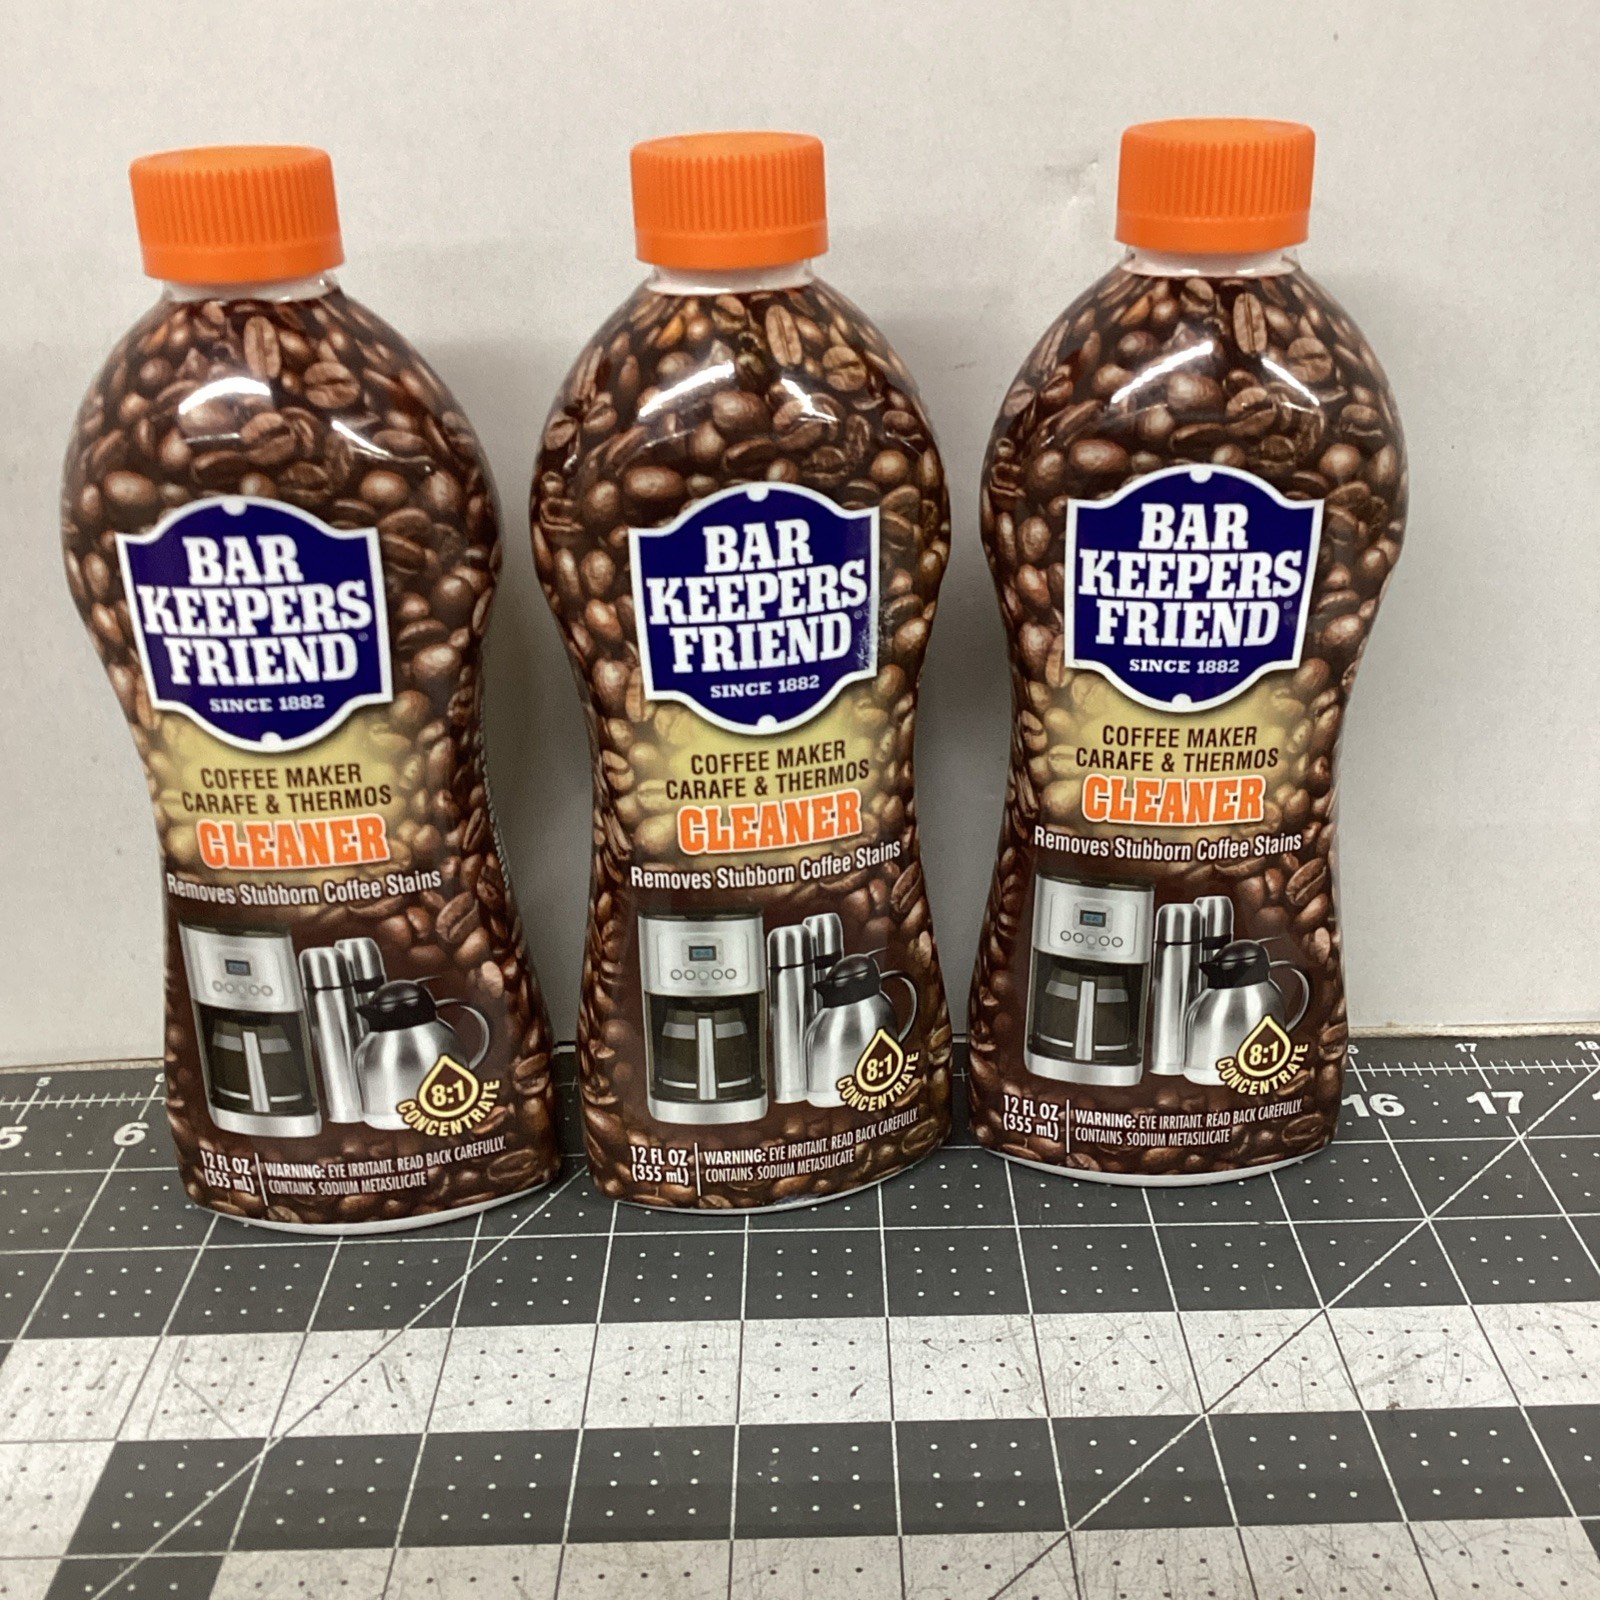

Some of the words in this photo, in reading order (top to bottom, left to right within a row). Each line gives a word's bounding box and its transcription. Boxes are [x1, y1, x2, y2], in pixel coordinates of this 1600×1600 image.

[1138, 503, 1249, 550] BAR
[182, 535, 304, 585] BAR
[703, 518, 813, 573] BAR
[1078, 549, 1302, 600] KEEPERS
[646, 559, 868, 625] KEEPERS
[137, 580, 372, 636] KEEPERS
[1095, 598, 1280, 647] FRIEND
[669, 612, 852, 673] FRIEND
[163, 633, 358, 686] FRIEND
[1129, 659, 1190, 674] SINCE
[1197, 659, 1239, 674] 1882
[710, 682, 772, 698] SINCE
[778, 675, 819, 692] 1882
[209, 697, 272, 713] SINCE
[279, 695, 325, 711] 1882
[1102, 724, 1180, 747] COFFEE
[1187, 726, 1257, 748] MAKER
[691, 754, 770, 775] COFFEE
[777, 740, 846, 769] MAKER
[1076, 747, 1153, 771] CARAFE
[1161, 753, 1175, 772] &
[1184, 747, 1279, 772] THERMOS
[200, 766, 279, 790] COFFEE
[286, 763, 361, 787] MAKER
[666, 776, 746, 800] CARAFE
[754, 776, 768, 795] &
[775, 759, 869, 793] THERMOS
[182, 791, 258, 815] CARAFE
[266, 795, 280, 813] &
[289, 786, 391, 811] THERMOS
[1082, 774, 1266, 826] CLEANER
[677, 788, 862, 855] CLEANER
[197, 814, 390, 869] CLEANER
[1034, 826, 1109, 857] Removes
[1114, 837, 1191, 861] Stubborn
[1196, 839, 1249, 861] Coffee
[1254, 833, 1302, 857] Stains
[630, 866, 712, 890] Removes
[717, 865, 795, 889] Stubborn
[800, 856, 851, 881] Coffee
[856, 841, 901, 869] Stains
[166, 873, 236, 905] Removes
[241, 883, 320, 906] Stubborn
[324, 879, 381, 903] Coffee
[388, 870, 442, 896] Stains
[1249, 1040, 1280, 1066] 8:1
[1455, 1043, 1479, 1053] 17
[1575, 1041, 1600, 1050] 18
[36, 1077, 51, 1087] 5
[837, 1051, 920, 1112] CONCENTRATE
[866, 1053, 892, 1083] 8:1
[1216, 1043, 1309, 1096] CONCENTRATE
[431, 1079, 465, 1107] 8:1
[1341, 1093, 1405, 1117] 16
[1466, 1091, 1524, 1115] 17
[398, 1080, 500, 1137] CONCENTRATE
[1003, 1095, 1018, 1115] 12
[1022, 1099, 1037, 1118] FL
[1039, 1103, 1059, 1122] OZ
[1075, 1109, 1136, 1129] WARNING:
[1138, 1115, 1157, 1130] EYE
[1205, 1112, 1231, 1127] READ
[1232, 1108, 1256, 1124] BACK
[0, 1125, 28, 1150] 5
[113, 1122, 149, 1146] 6
[1003, 1113, 1032, 1134] (355
[1035, 1121, 1059, 1141] mL)
[1075, 1129, 1123, 1145] CONTAINS
[1126, 1131, 1166, 1147] SODIUM
[1168, 1127, 1231, 1147] METASILICATE
[631, 1146, 647, 1164] 12
[650, 1148, 665, 1165] FL
[668, 1149, 688, 1167] OZ
[704, 1149, 767, 1166] WARNING:
[769, 1146, 786, 1162] EYE
[831, 1131, 854, 1150] READ
[855, 1125, 877, 1143] BACK
[200, 1151, 215, 1170] 12
[218, 1156, 231, 1173] FL
[232, 1157, 251, 1175] OZ
[264, 1161, 326, 1179] WARNING:
[327, 1164, 347, 1178] EYE
[397, 1156, 423, 1173] READ
[427, 1150, 452, 1167] BACK
[632, 1164, 662, 1182] (355
[665, 1167, 690, 1186] mL)
[705, 1165, 754, 1183] CONTAINS
[757, 1161, 795, 1180] SODIUM
[797, 1149, 855, 1176] METASILICATE
[204, 1169, 231, 1189] (355
[233, 1177, 255, 1194] mL)
[268, 1179, 316, 1195] CONTAINS
[318, 1180, 358, 1196] SODIUM
[361, 1172, 427, 1194] METASILICATE
